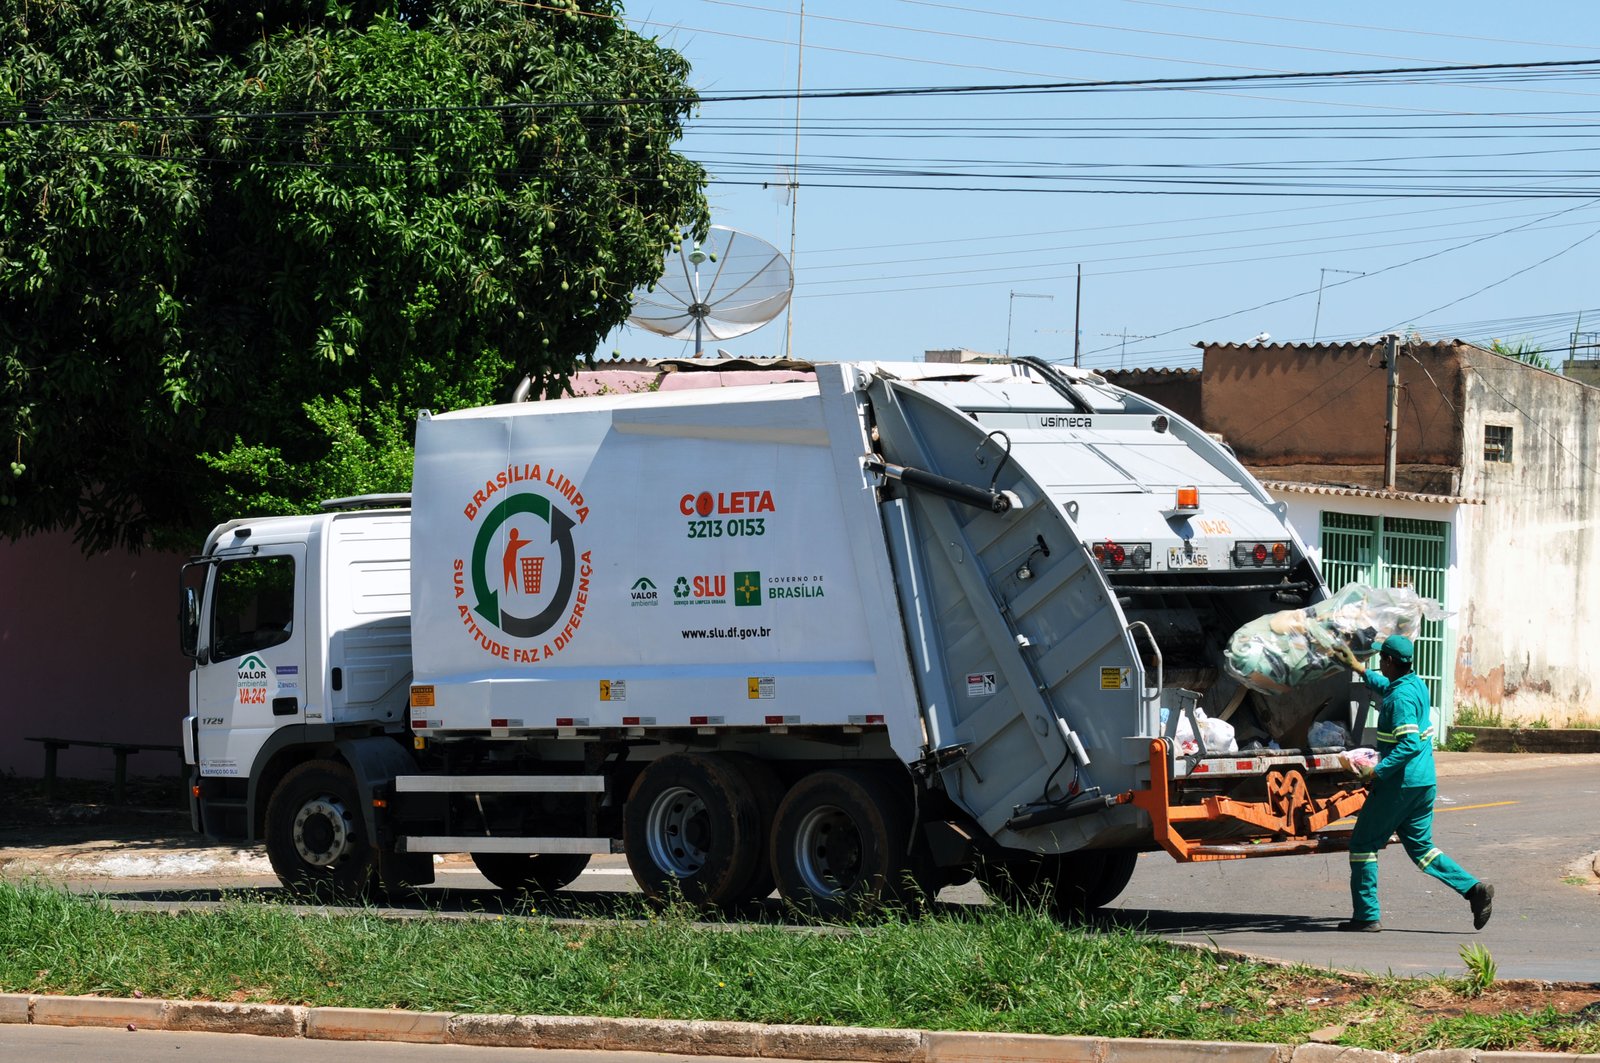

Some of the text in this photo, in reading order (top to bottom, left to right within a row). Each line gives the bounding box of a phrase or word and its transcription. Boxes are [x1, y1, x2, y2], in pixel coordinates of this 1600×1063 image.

[1040, 415, 1092, 428] usimeca
[464, 464, 590, 524] BRASÍLIA LIMPA
[680, 490, 775, 517] COLETA
[687, 518, 765, 538] 3213 0153
[1197, 519, 1232, 535] VA-243
[693, 575, 726, 598] SLU
[768, 583, 825, 599] BRASÍLIA
[631, 591, 658, 600] VALOR
[453, 550, 594, 663] SUA ATITUDE FAZ A DIFERENÇA
[681, 626, 771, 640] www.slu.df.gov.br
[238, 671, 267, 679] VALOR
[238, 680, 268, 688] ambiental
[239, 688, 267, 704] VA-243
